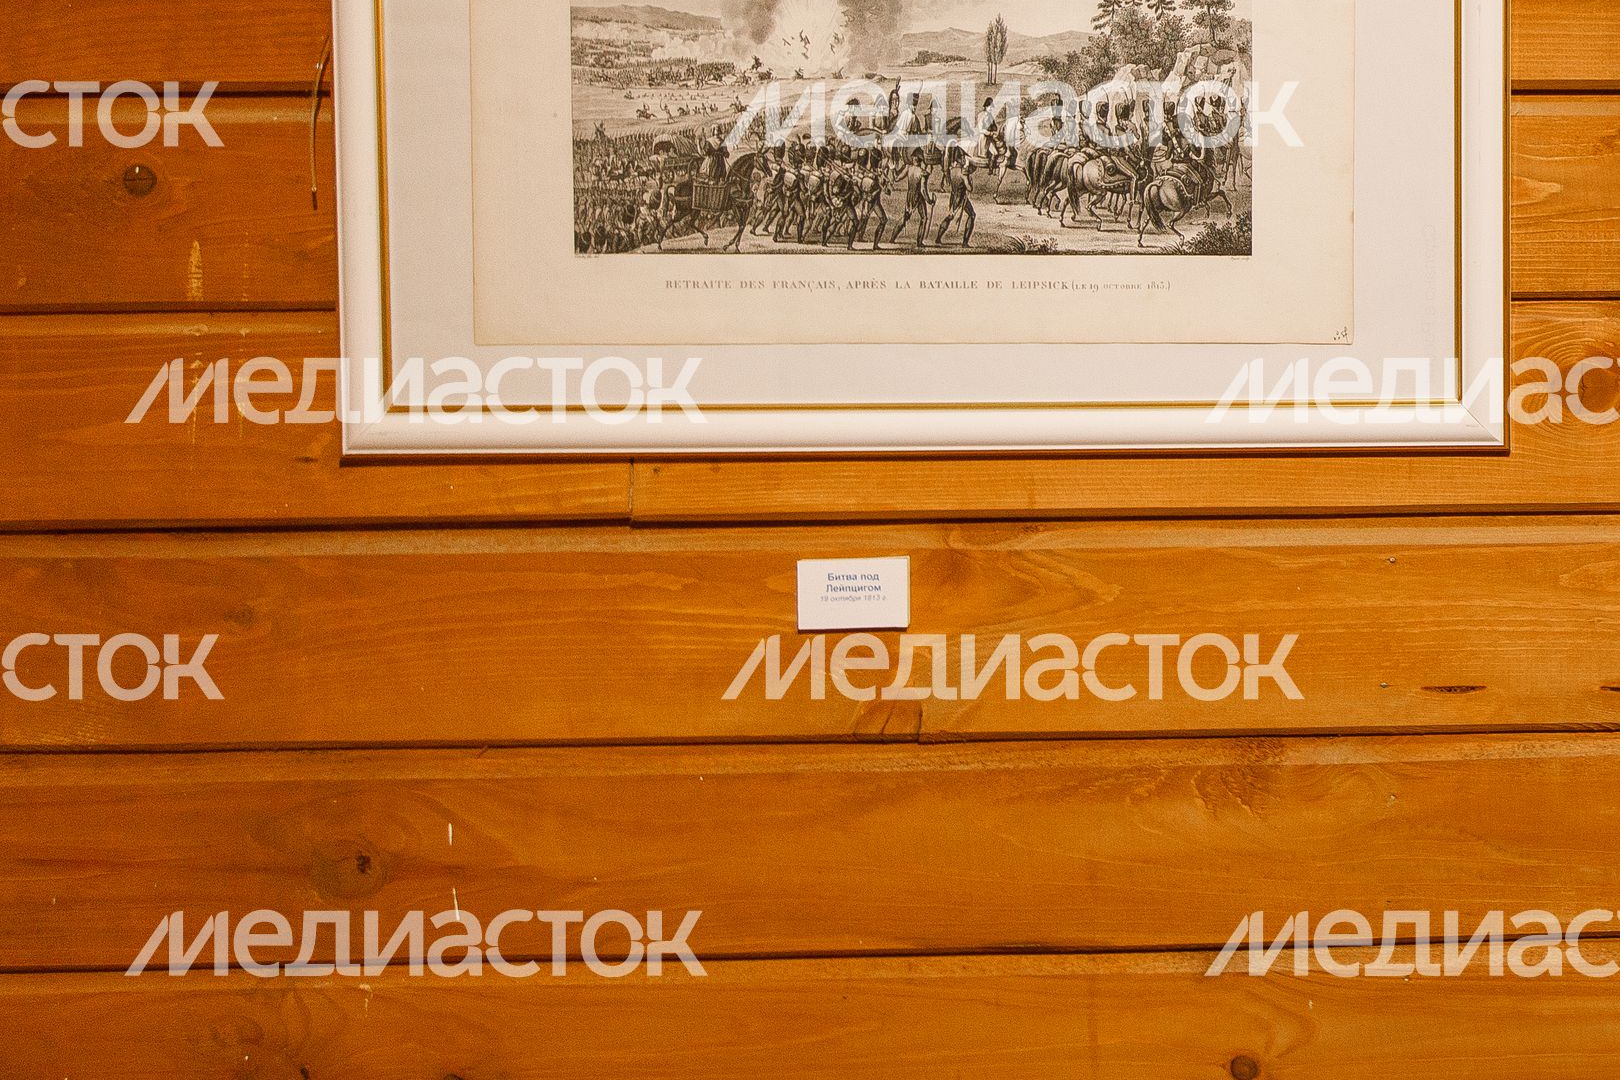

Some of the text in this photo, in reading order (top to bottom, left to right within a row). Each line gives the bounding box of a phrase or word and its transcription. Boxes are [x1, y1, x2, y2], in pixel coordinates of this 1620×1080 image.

[665, 280, 732, 290] RETRAITE
[740, 280, 765, 290] DES
[773, 280, 841, 293] FRANÇAIS,
[846, 277, 887, 290] APRÈS
[895, 280, 911, 289] LA
[919, 280, 978, 290] BATAILLE
[987, 280, 1003, 289] DE
[1011, 280, 1069, 290] LEIPSICK
[827, 573, 880, 581] Битва под
[826, 584, 881, 593] Лейпцигом
